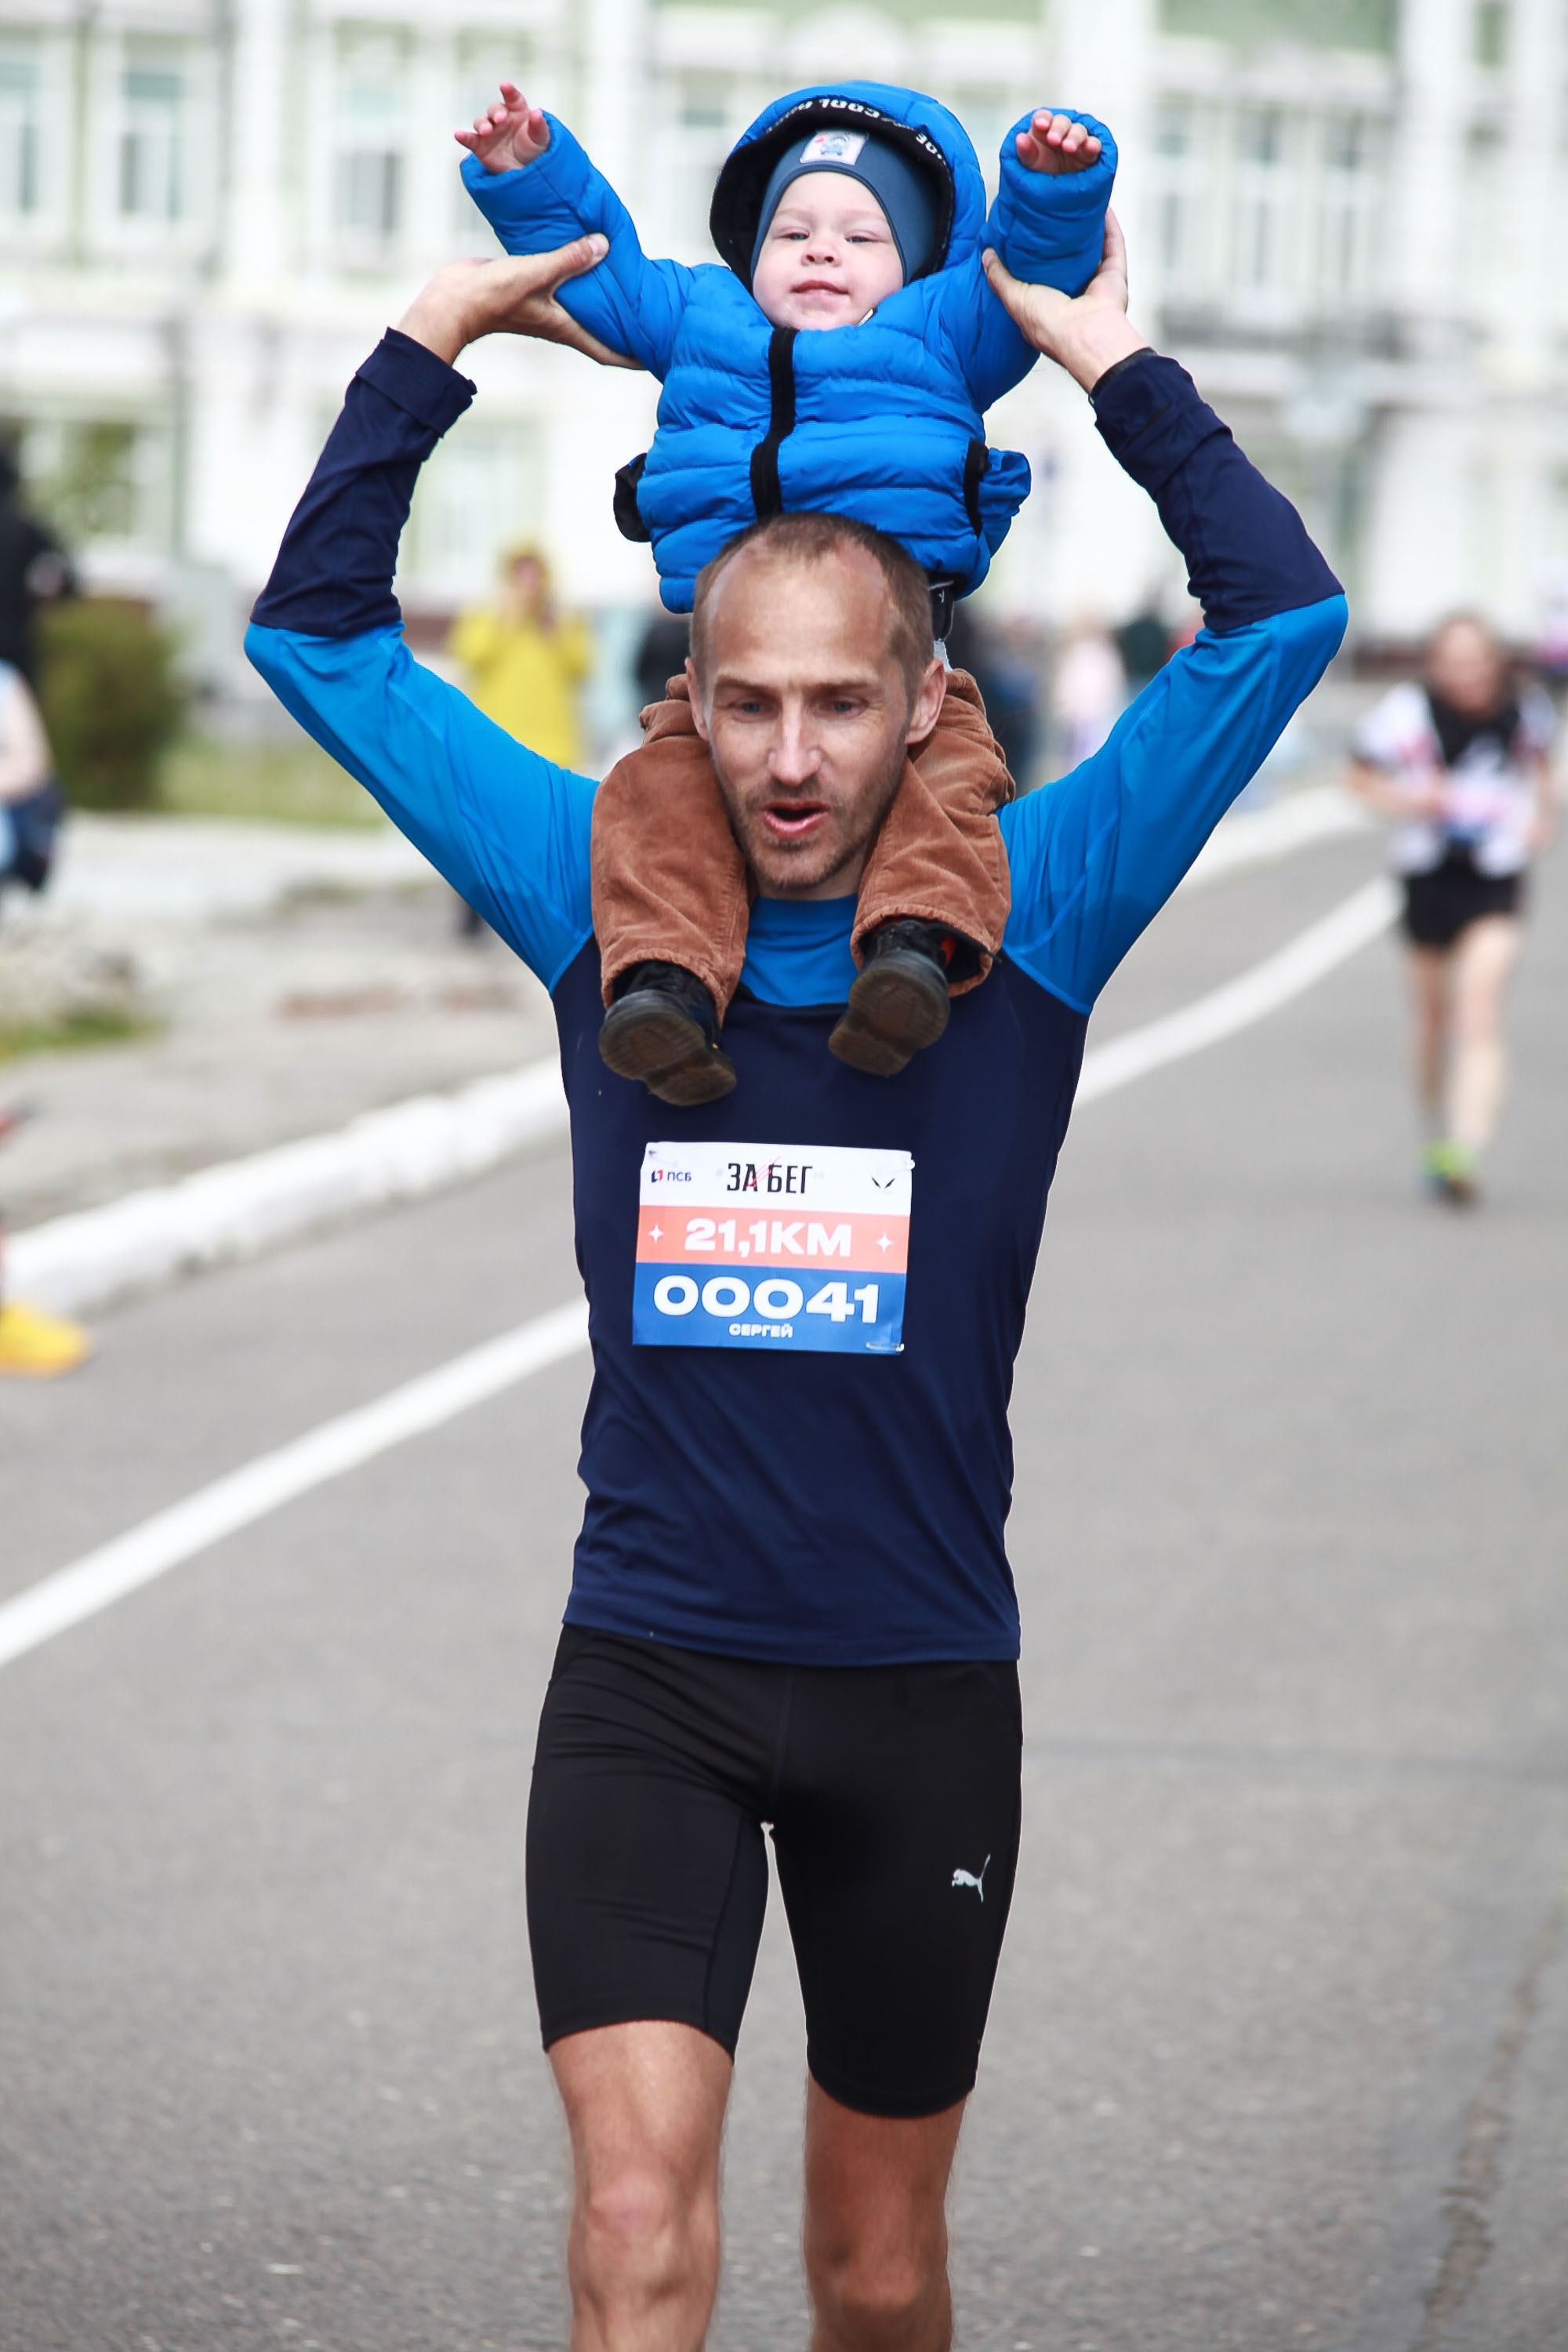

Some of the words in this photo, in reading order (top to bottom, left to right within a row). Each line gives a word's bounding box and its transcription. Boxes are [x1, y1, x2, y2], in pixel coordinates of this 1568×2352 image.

[667, 1171, 692, 1181] ПСБ
[653, 1275, 879, 1323] 00041
[728, 1323, 793, 1338] СЕРГЕЙ
